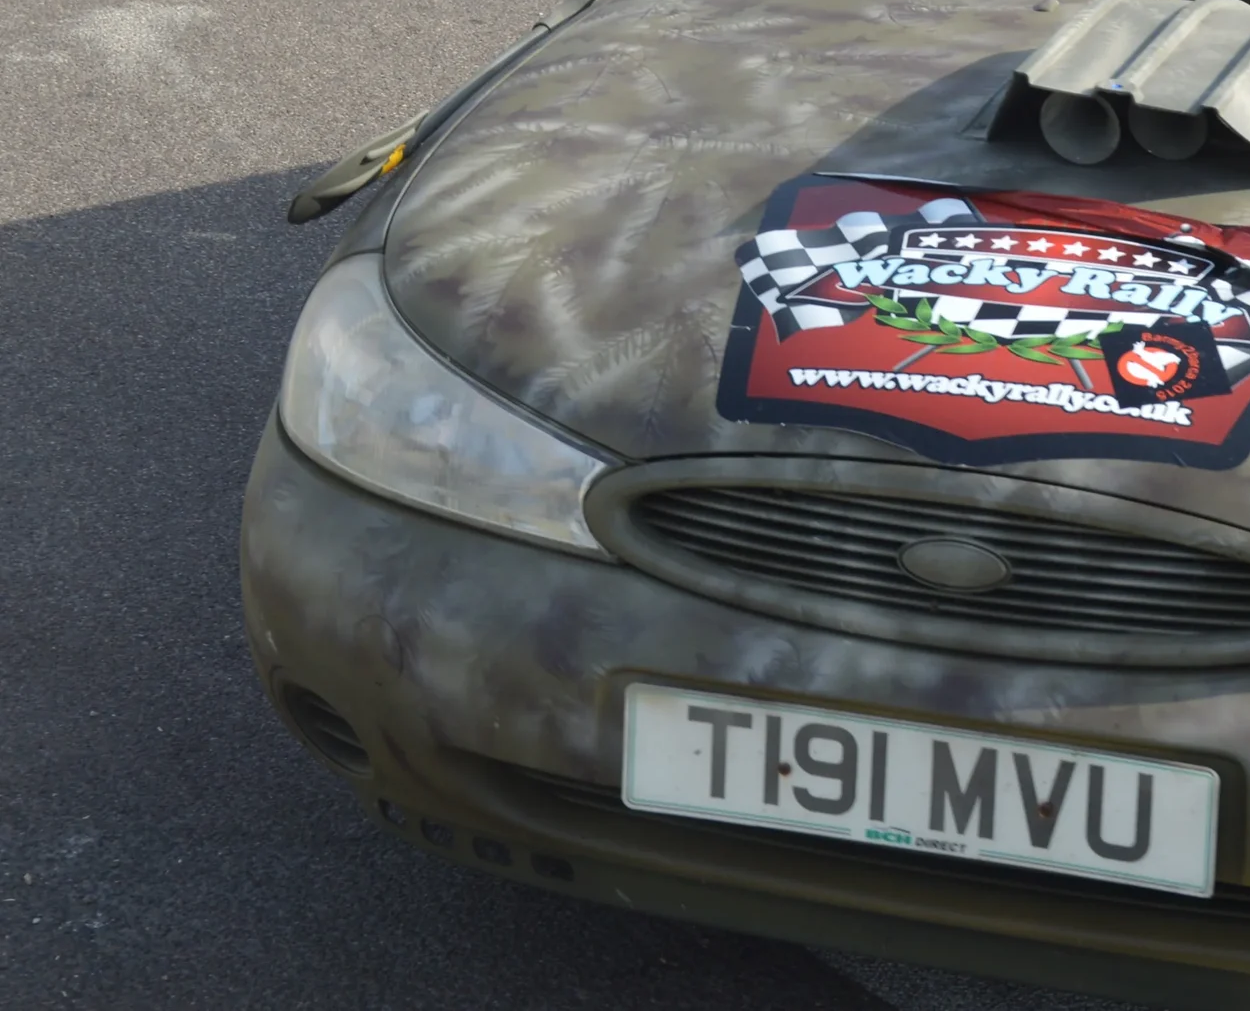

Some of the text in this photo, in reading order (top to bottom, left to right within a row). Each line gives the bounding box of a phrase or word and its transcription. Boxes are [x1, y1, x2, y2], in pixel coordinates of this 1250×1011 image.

[833, 257, 1243, 326] Wacky Rally
[687, 705, 1155, 863] T191 MVU
